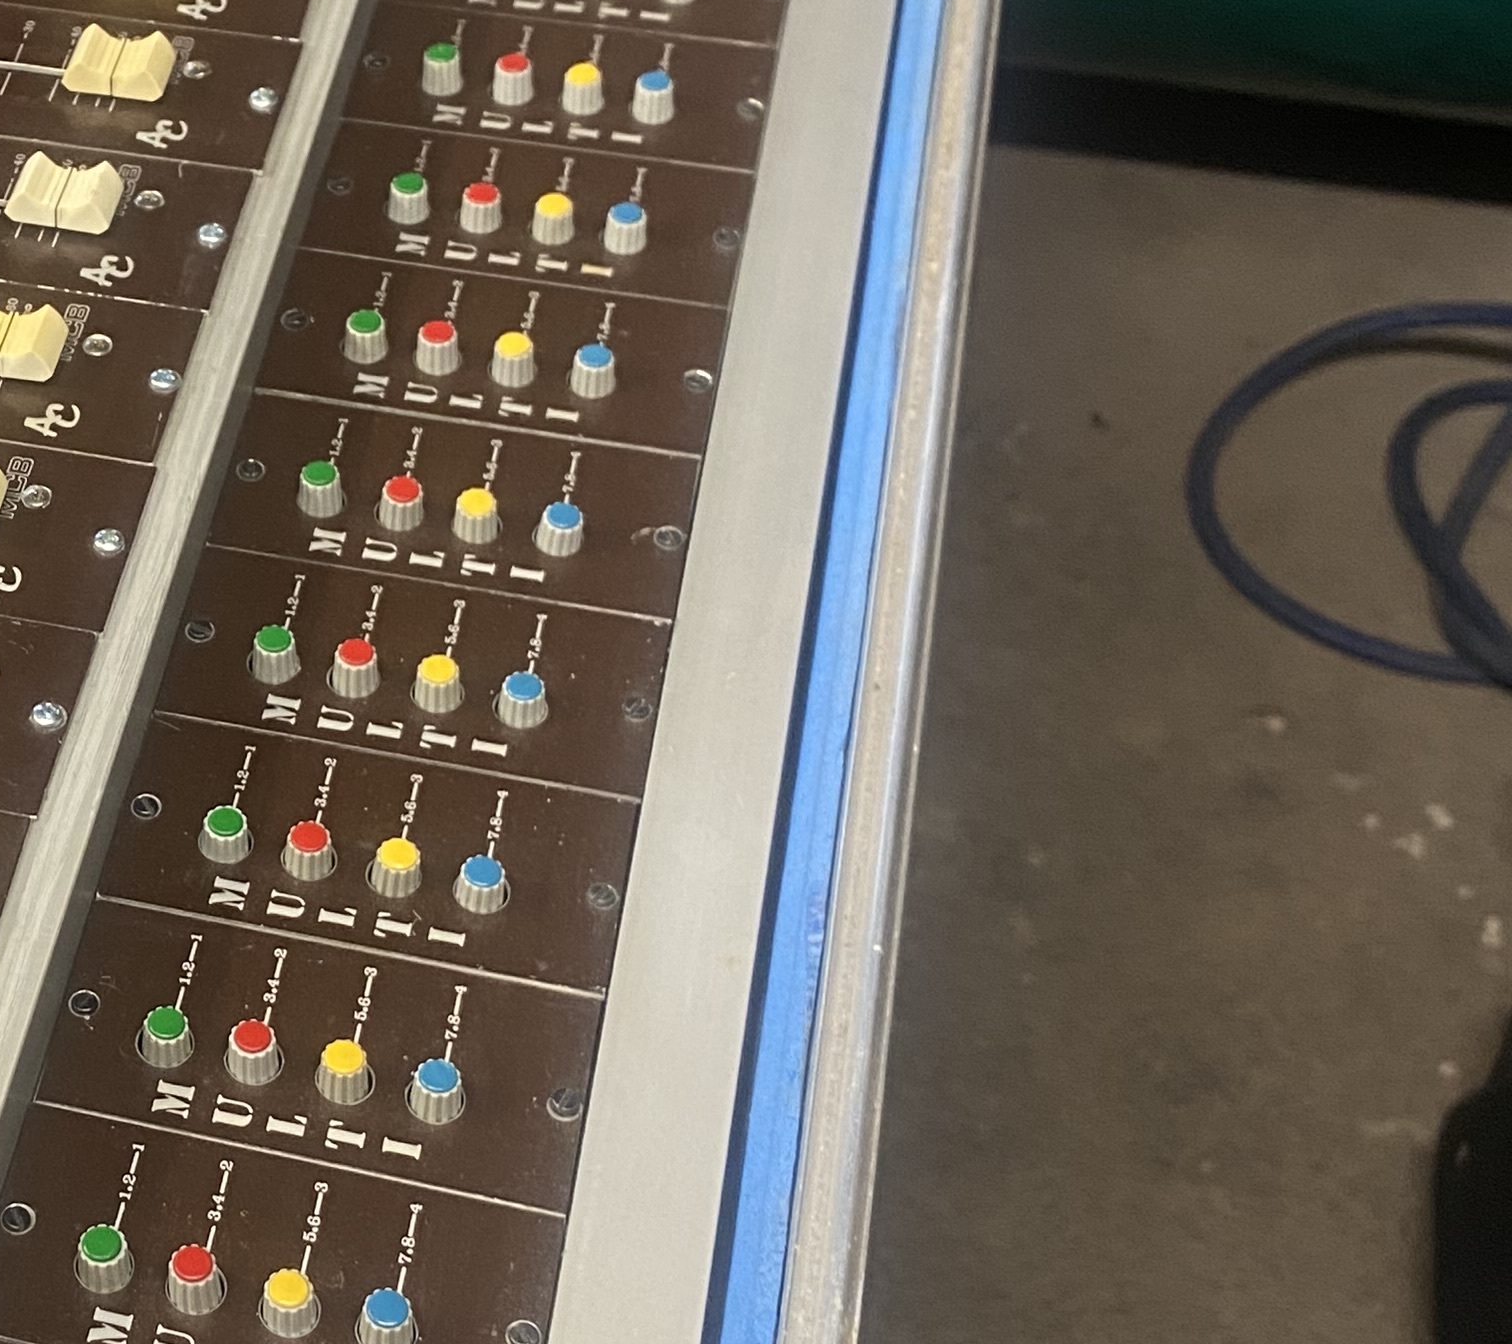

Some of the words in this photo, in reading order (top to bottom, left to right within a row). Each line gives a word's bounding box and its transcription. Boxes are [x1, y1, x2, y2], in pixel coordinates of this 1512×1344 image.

[261, 694, 508, 756] MULTI
[209, 876, 466, 946] MULTI
[151, 1080, 422, 1159] MULTI
